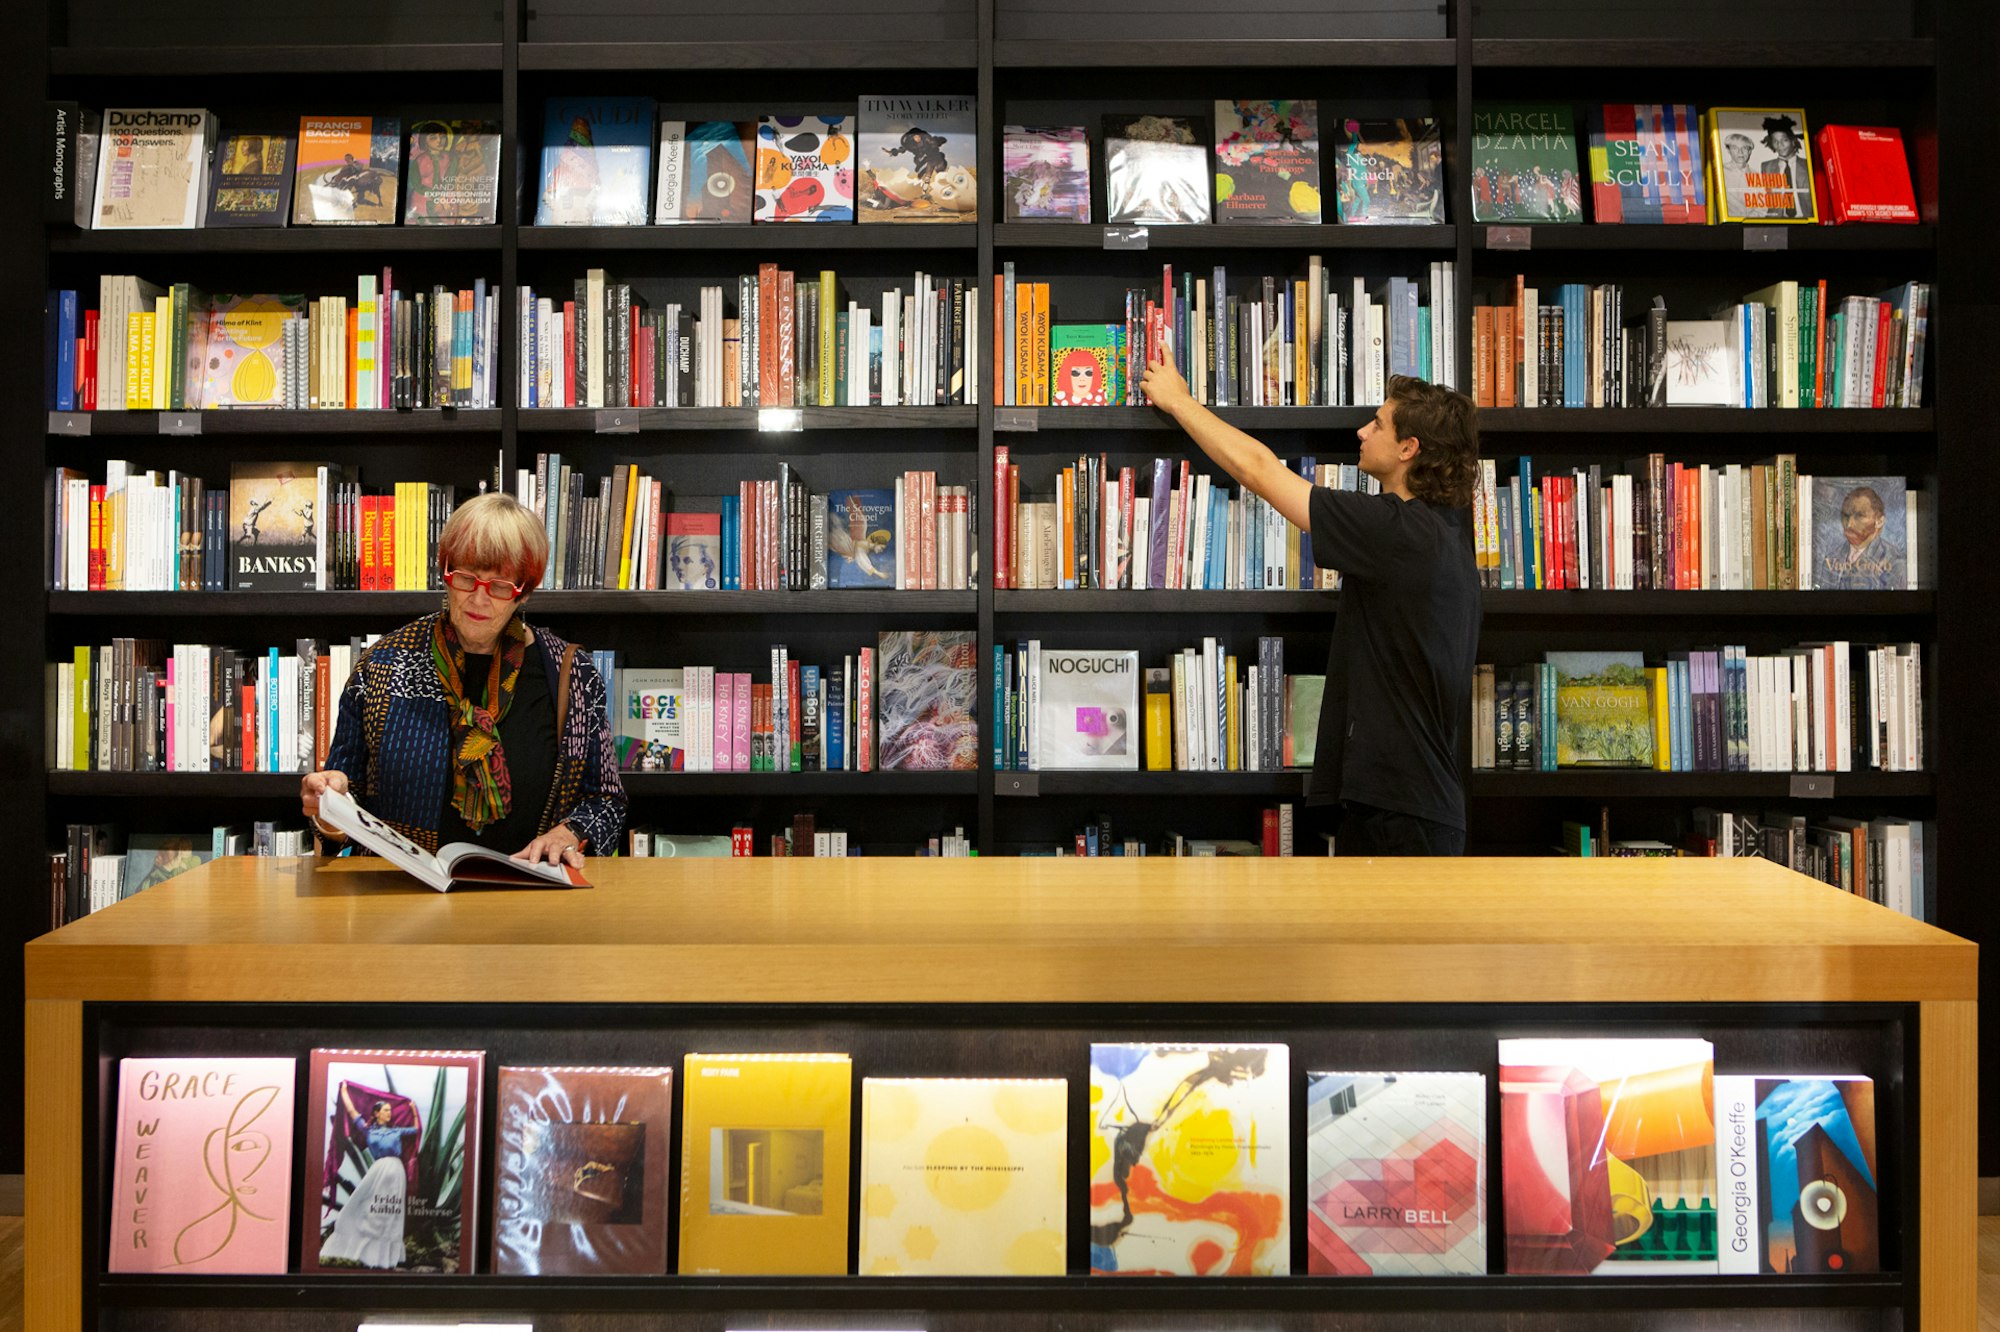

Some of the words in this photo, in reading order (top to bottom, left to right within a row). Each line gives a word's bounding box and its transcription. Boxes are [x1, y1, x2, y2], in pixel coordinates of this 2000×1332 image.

[865, 100, 898, 112] TIM
[900, 100, 969, 112] WALKER
[56, 109, 67, 135] Artist
[109, 111, 201, 127] Duchamp
[306, 121, 362, 130] FRANCIS
[1474, 113, 1566, 130] MARCEL
[113, 128, 131, 136] 100
[131, 128, 184, 136] Questions.
[1476, 133, 1568, 150] DZAMA
[790, 155, 821, 163] YAYOI
[1345, 153, 1377, 167] Neo
[1614, 139, 1676, 157] SEAN
[54, 137, 67, 200] Monographs
[781, 163, 829, 171] KUSAMA
[1346, 168, 1395, 181] Rauch
[1603, 169, 1693, 187] SCULLY
[664, 173, 679, 210] Georgia
[1744, 172, 1791, 188] WARHOL
[1744, 192, 1795, 209] BASQUIAT
[1527, 296, 1535, 318] SEAN
[128, 316, 139, 353] HILMA
[142, 316, 152, 353] HILMA
[216, 319, 234, 327] Hilma
[1020, 311, 1028, 336] YAYOI
[1037, 311, 1045, 336] YAYOI
[1527, 319, 1535, 348] SCULLY
[838, 328, 846, 344] Tom
[1785, 316, 1797, 361] Spilliaert
[128, 354, 139, 366] AF
[142, 354, 152, 366] AF
[679, 336, 690, 373] DUCHAMP
[838, 345, 846, 382] Eckersley
[1020, 338, 1028, 379] KUSAMA
[1037, 338, 1045, 379] KUSAMA
[128, 368, 139, 401] KLINT
[142, 368, 152, 401] KLINT
[1527, 357, 1535, 387] HUMAN
[177, 419, 182, 427] B
[835, 504, 850, 514] The
[851, 504, 893, 514] Scrovegni
[848, 513, 878, 522] Chapel
[1741, 497, 1750, 514] Ulay
[1204, 521, 1212, 543] MONA
[1475, 499, 1484, 549] STOCKHOLDER
[1487, 499, 1496, 549] STOCKHOLDER
[361, 510, 377, 568] Basquiat
[378, 510, 395, 568] Basquiat
[1022, 517, 1031, 567] Michelangelo
[1168, 517, 1177, 558] SHELTER
[1741, 520, 1750, 556] Life-Sized
[1042, 525, 1052, 576] Michelangelo
[1204, 544, 1212, 562] LISA
[238, 556, 317, 574] BANKSY
[1825, 557, 1852, 572] Van
[1855, 557, 1893, 577] Gogh
[1049, 658, 1129, 674] NOGUCHI
[102, 678, 111, 701] Beuys
[270, 677, 278, 711] BOTERO
[303, 666, 314, 721] Bouchardon
[628, 695, 682, 707] HOCK
[804, 669, 818, 726] Hogarth
[861, 666, 869, 738] HOPPER
[1019, 650, 1027, 752] NARA
[1560, 695, 1593, 709] VAN
[1596, 694, 1640, 709] GOGH
[628, 707, 679, 719] NEYS
[717, 684, 729, 742] HOCKNEY
[736, 684, 748, 742] HOCKNEY
[1498, 698, 1511, 720] Van
[1515, 698, 1529, 720] Van
[102, 709, 111, 745] Duchamp
[1498, 721, 1511, 752] Gogh
[1515, 721, 1529, 752] Gogh
[1796, 846, 1805, 871] Joseph
[140, 1070, 236, 1102] GRACE
[1731, 1101, 1751, 1176] O'Keeffe
[132, 1117, 161, 1250] WEAVER
[369, 1204, 402, 1214] Kahlo
[407, 1206, 454, 1217] Universe
[374, 1194, 402, 1205] Frida
[407, 1194, 429, 1206] Her
[1343, 1204, 1403, 1220] LARRY
[1404, 1209, 1453, 1225] BELL
[1731, 1181, 1751, 1254] Georgia
